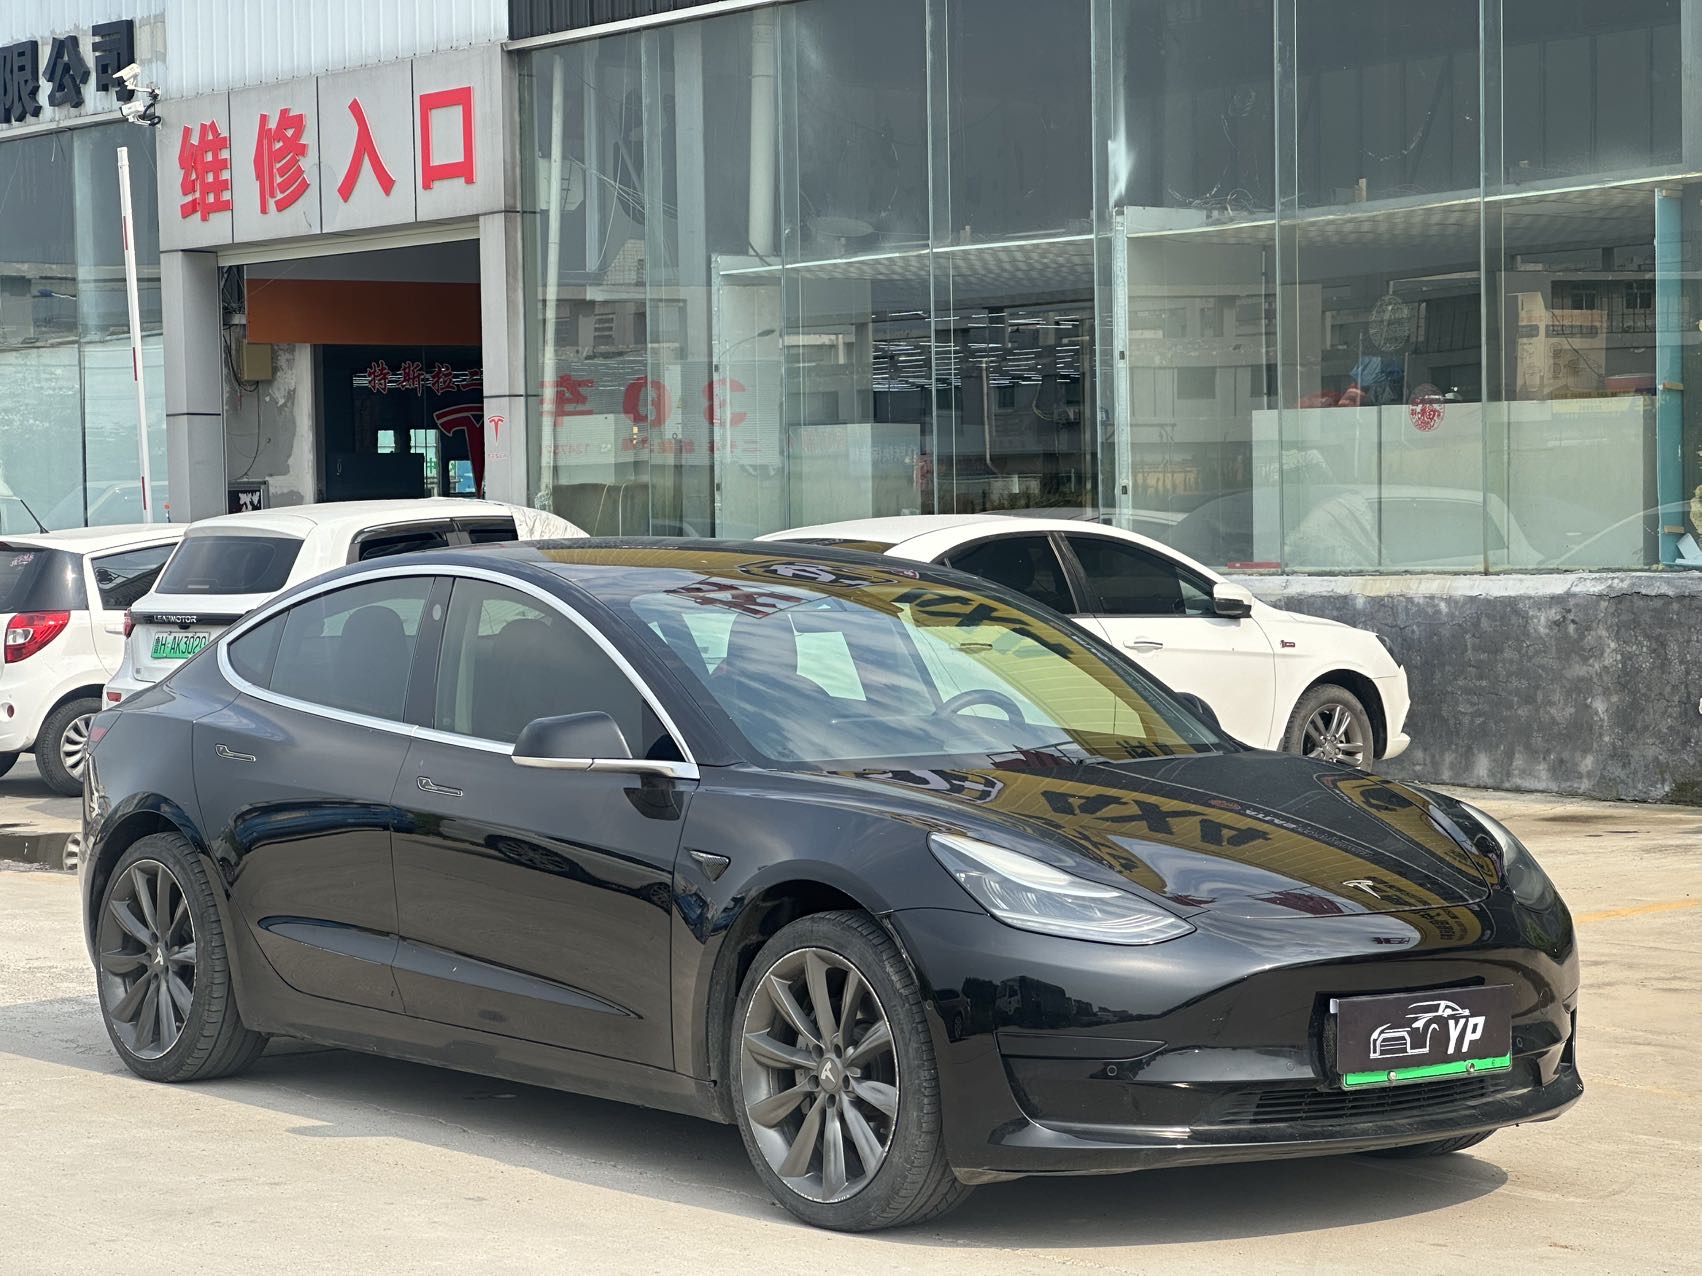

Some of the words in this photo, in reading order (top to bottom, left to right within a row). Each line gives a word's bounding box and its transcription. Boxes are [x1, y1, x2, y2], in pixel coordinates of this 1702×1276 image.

[0, 19, 135, 123] 限公司
[178, 85, 476, 221] 维修入口
[1446, 1016, 1486, 1055] YP
